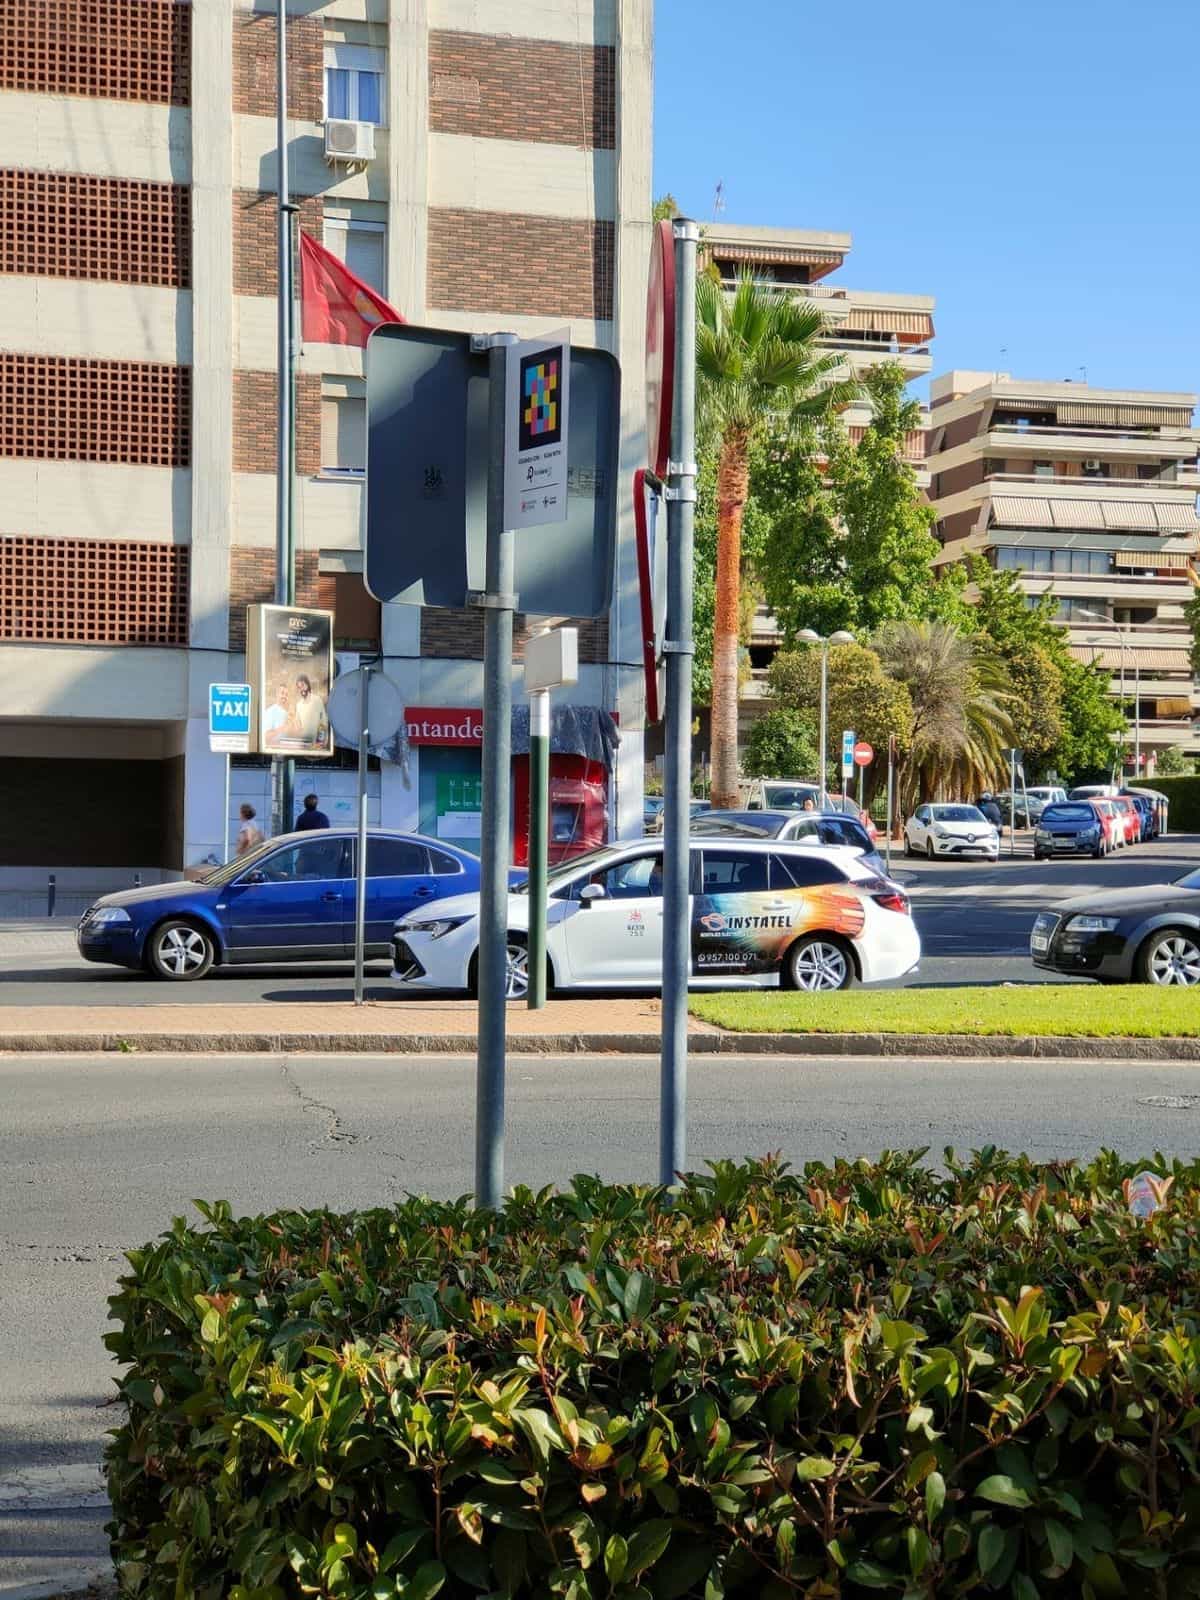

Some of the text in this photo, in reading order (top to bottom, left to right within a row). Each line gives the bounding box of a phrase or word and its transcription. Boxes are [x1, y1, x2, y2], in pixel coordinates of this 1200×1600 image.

[213, 701, 248, 717] TAXI
[407, 717, 483, 739] ntande
[728, 915, 793, 929] INSTATEL
[706, 952, 757, 961] 957 100 071
